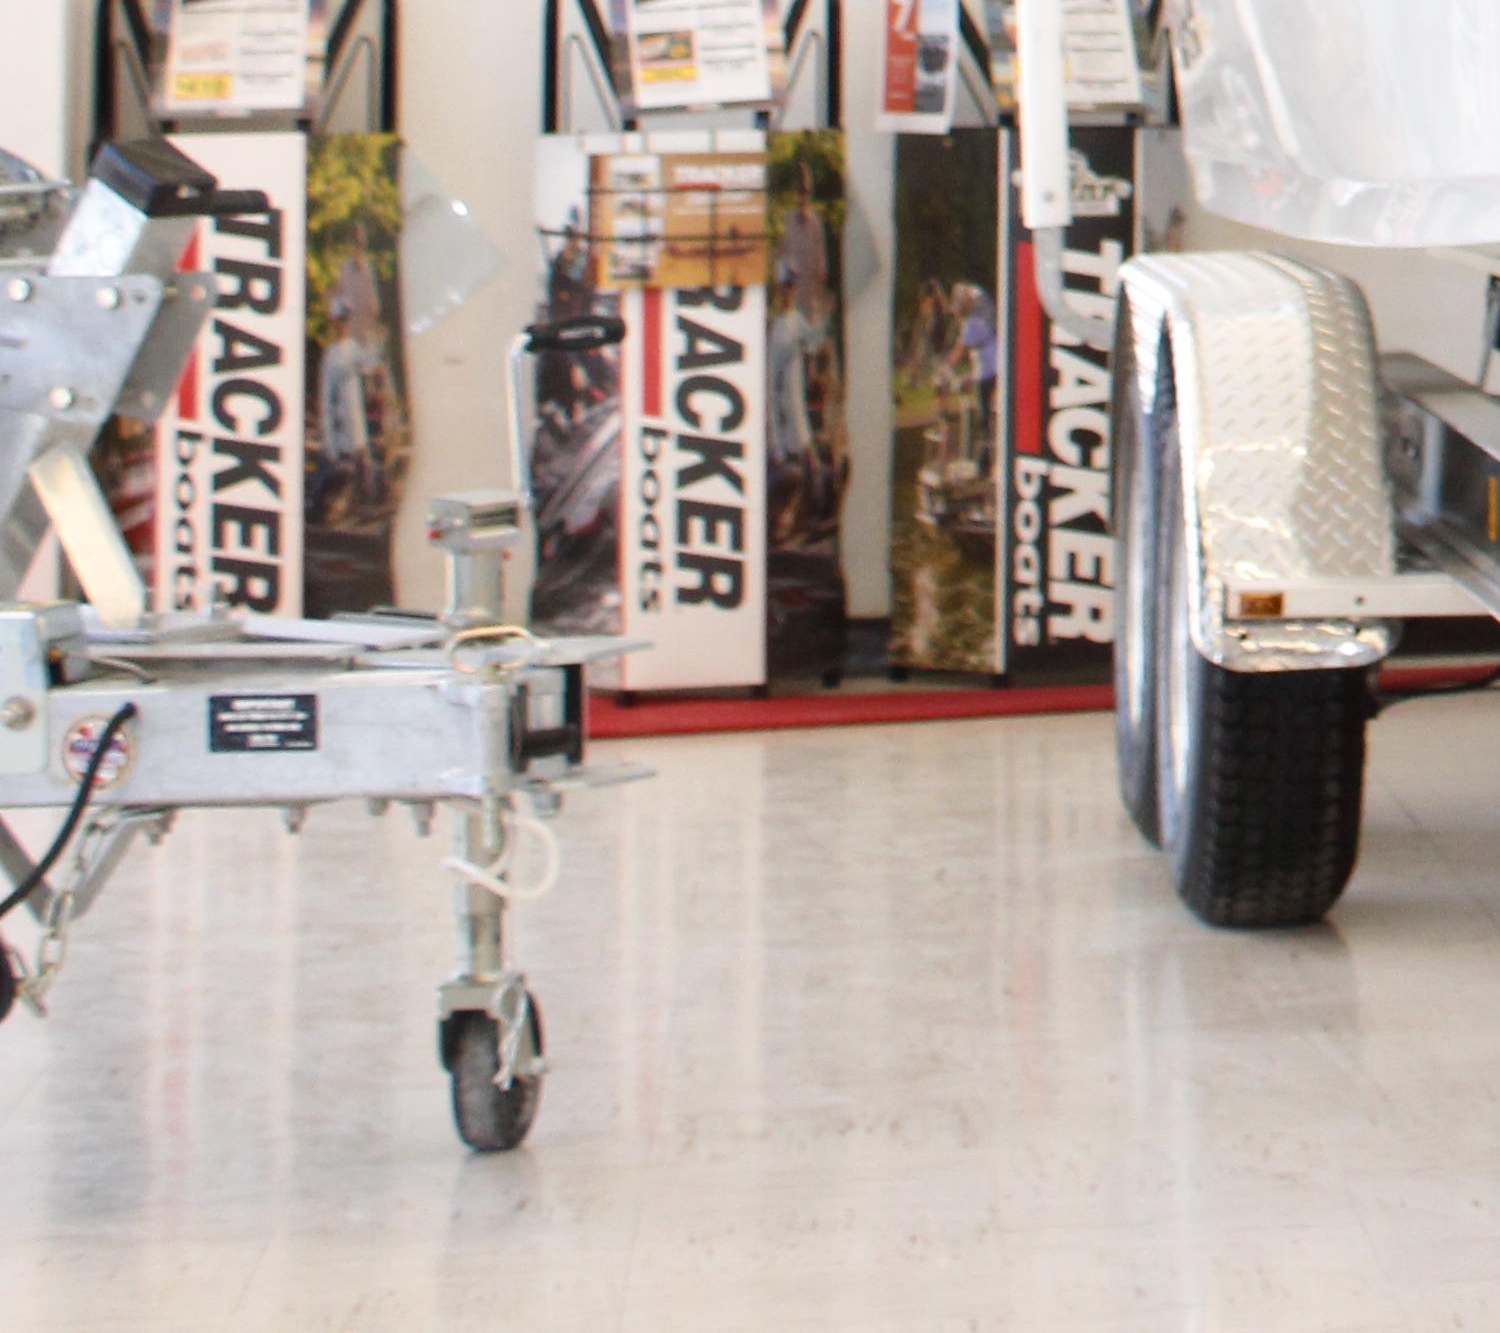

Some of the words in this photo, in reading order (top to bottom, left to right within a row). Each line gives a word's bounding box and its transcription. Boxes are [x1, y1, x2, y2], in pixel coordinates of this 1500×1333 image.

[209, 207, 284, 615] TRACKER
[638, 427, 669, 615] boats
[673, 284, 747, 614] RACKER
[1014, 455, 1043, 649] boats
